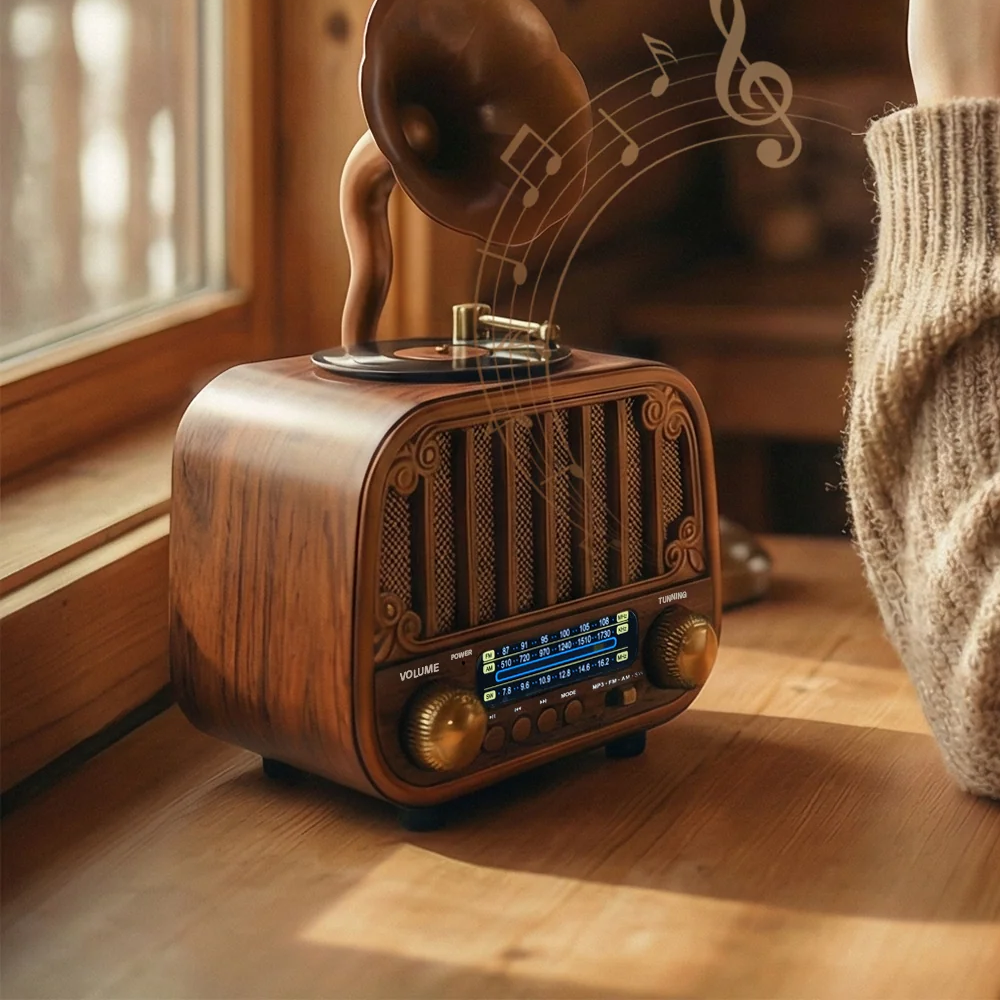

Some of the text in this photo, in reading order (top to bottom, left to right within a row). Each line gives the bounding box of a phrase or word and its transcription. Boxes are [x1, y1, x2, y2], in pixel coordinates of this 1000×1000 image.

[658, 591, 687, 604] TUNNING
[501, 658, 512, 668] 510
[519, 653, 530, 662] 720
[539, 647, 550, 657] 970
[558, 641, 572, 651] 1240
[578, 635, 592, 645] 1510
[597, 629, 611, 640] 1730
[502, 645, 509, 655] 87
[521, 641, 528, 650] 91
[560, 629, 570, 638] 100
[580, 622, 590, 632] 105
[451, 649, 473, 661] POWER
[400, 662, 439, 682] VOLUME
[502, 686, 511, 696] 7.8
[520, 681, 530, 691] 9.6
[539, 675, 551, 685] 10.9
[559, 669, 571, 679] 12.8
[578, 663, 591, 673] 14.6
[597, 658, 610, 667] 16.2
